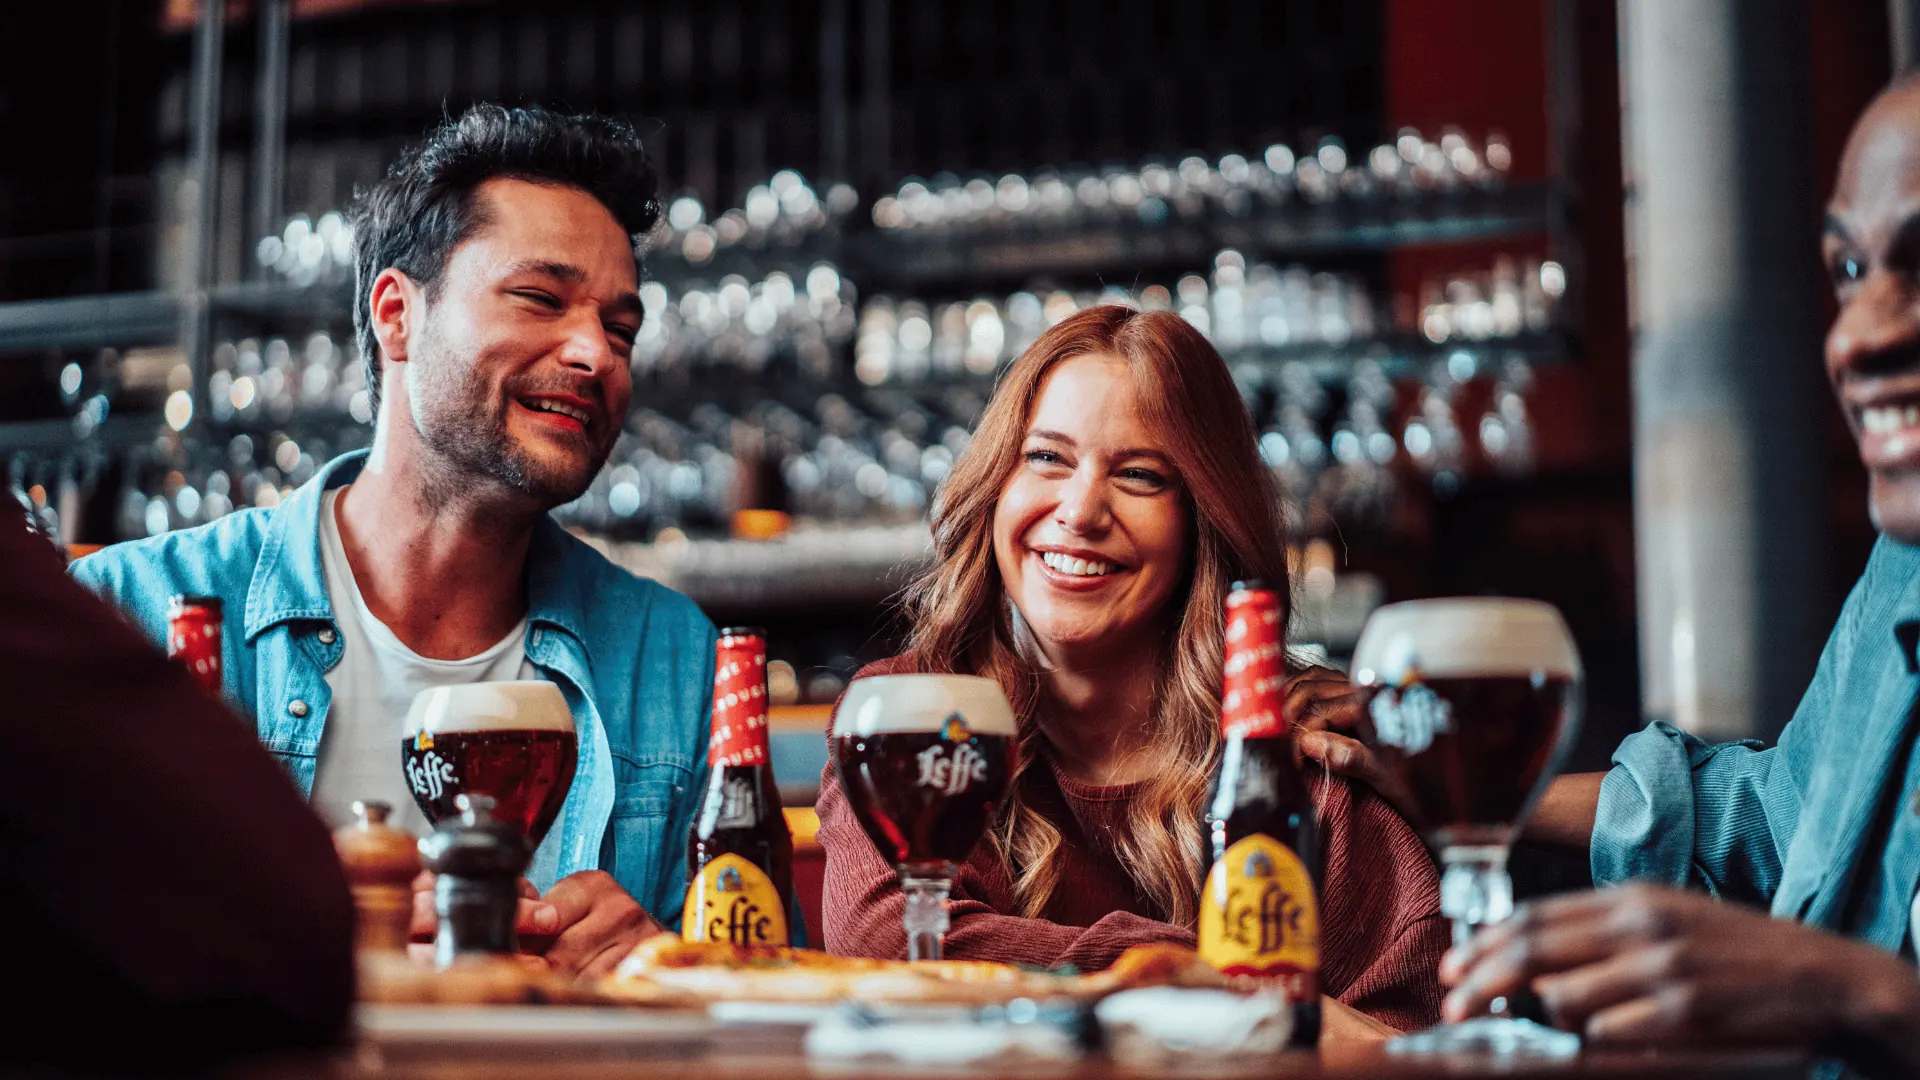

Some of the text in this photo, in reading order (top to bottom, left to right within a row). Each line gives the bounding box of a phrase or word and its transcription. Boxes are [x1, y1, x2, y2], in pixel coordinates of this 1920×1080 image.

[407, 751, 459, 800] Leffe
[917, 744, 987, 796] Leffe
[1221, 880, 1304, 955] Leffe
